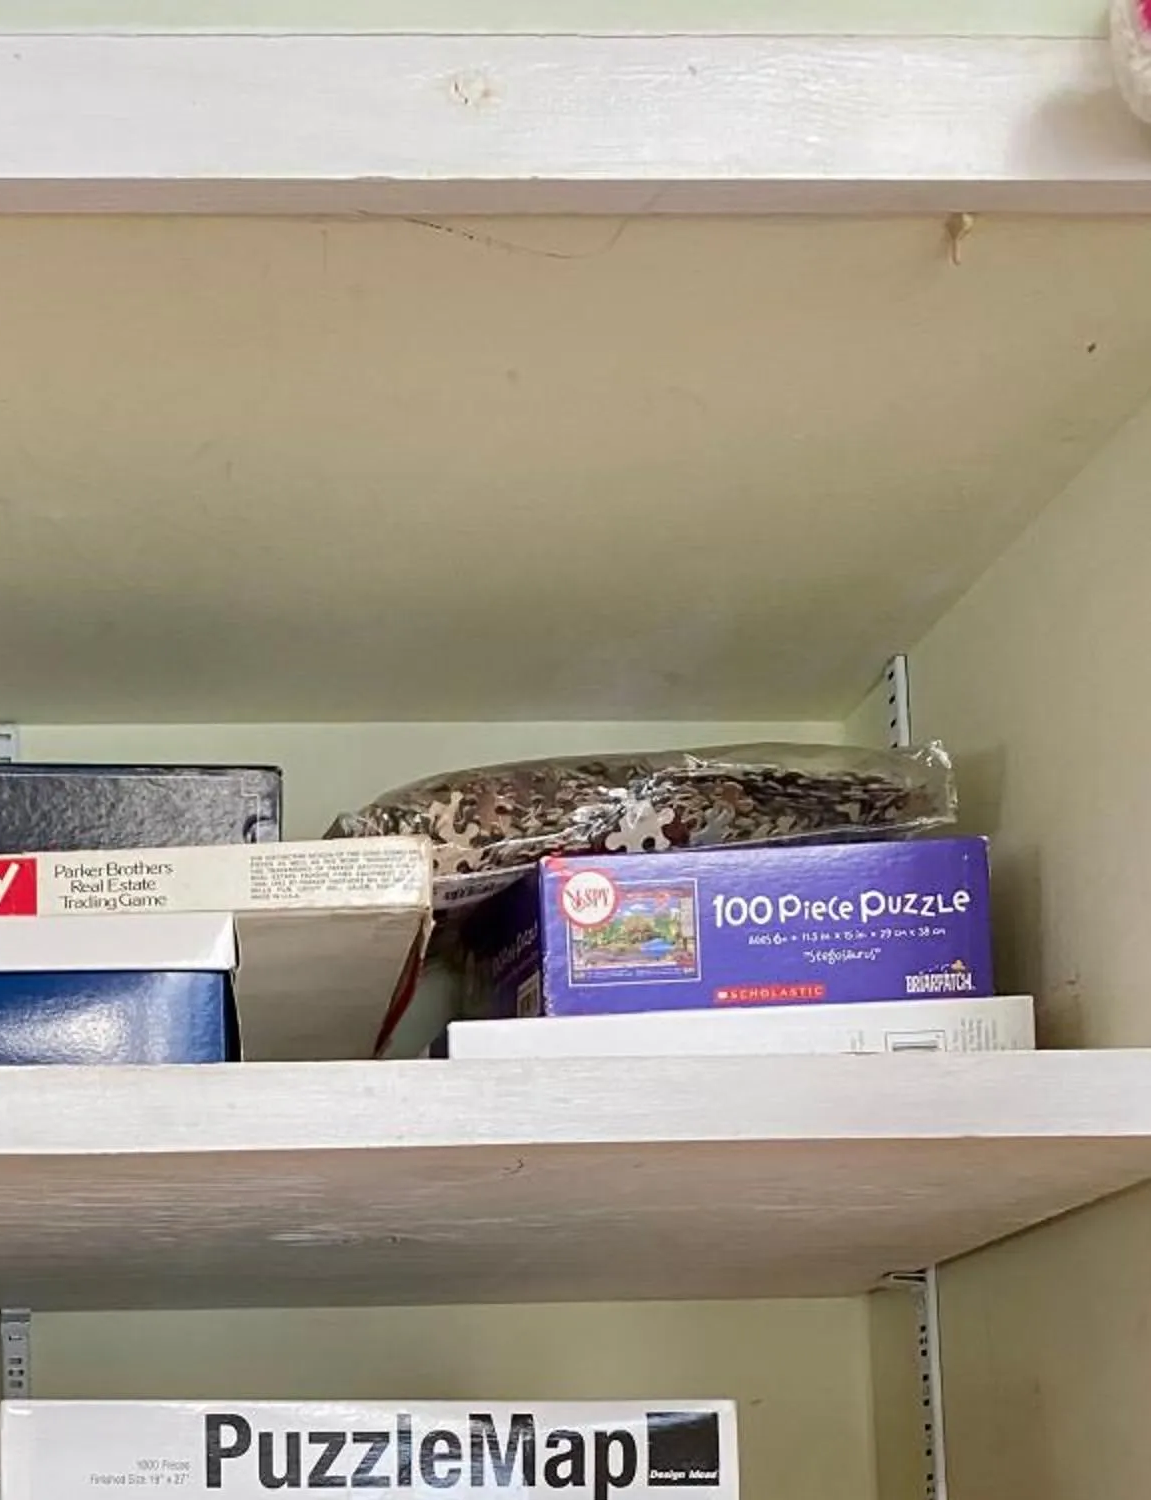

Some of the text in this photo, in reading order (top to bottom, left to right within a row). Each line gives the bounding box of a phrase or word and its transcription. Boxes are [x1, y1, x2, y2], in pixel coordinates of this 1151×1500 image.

[54, 861, 174, 879] Parker Brothers
[70, 877, 156, 894] Real Estate
[59, 893, 168, 911] Trading Game
[712, 894, 774, 928] 100
[779, 894, 853, 924] Piece
[905, 972, 973, 993] BRIARPATCH
[730, 984, 824, 1000] SCHOLASTIC
[649, 1469, 686, 1481] Design
